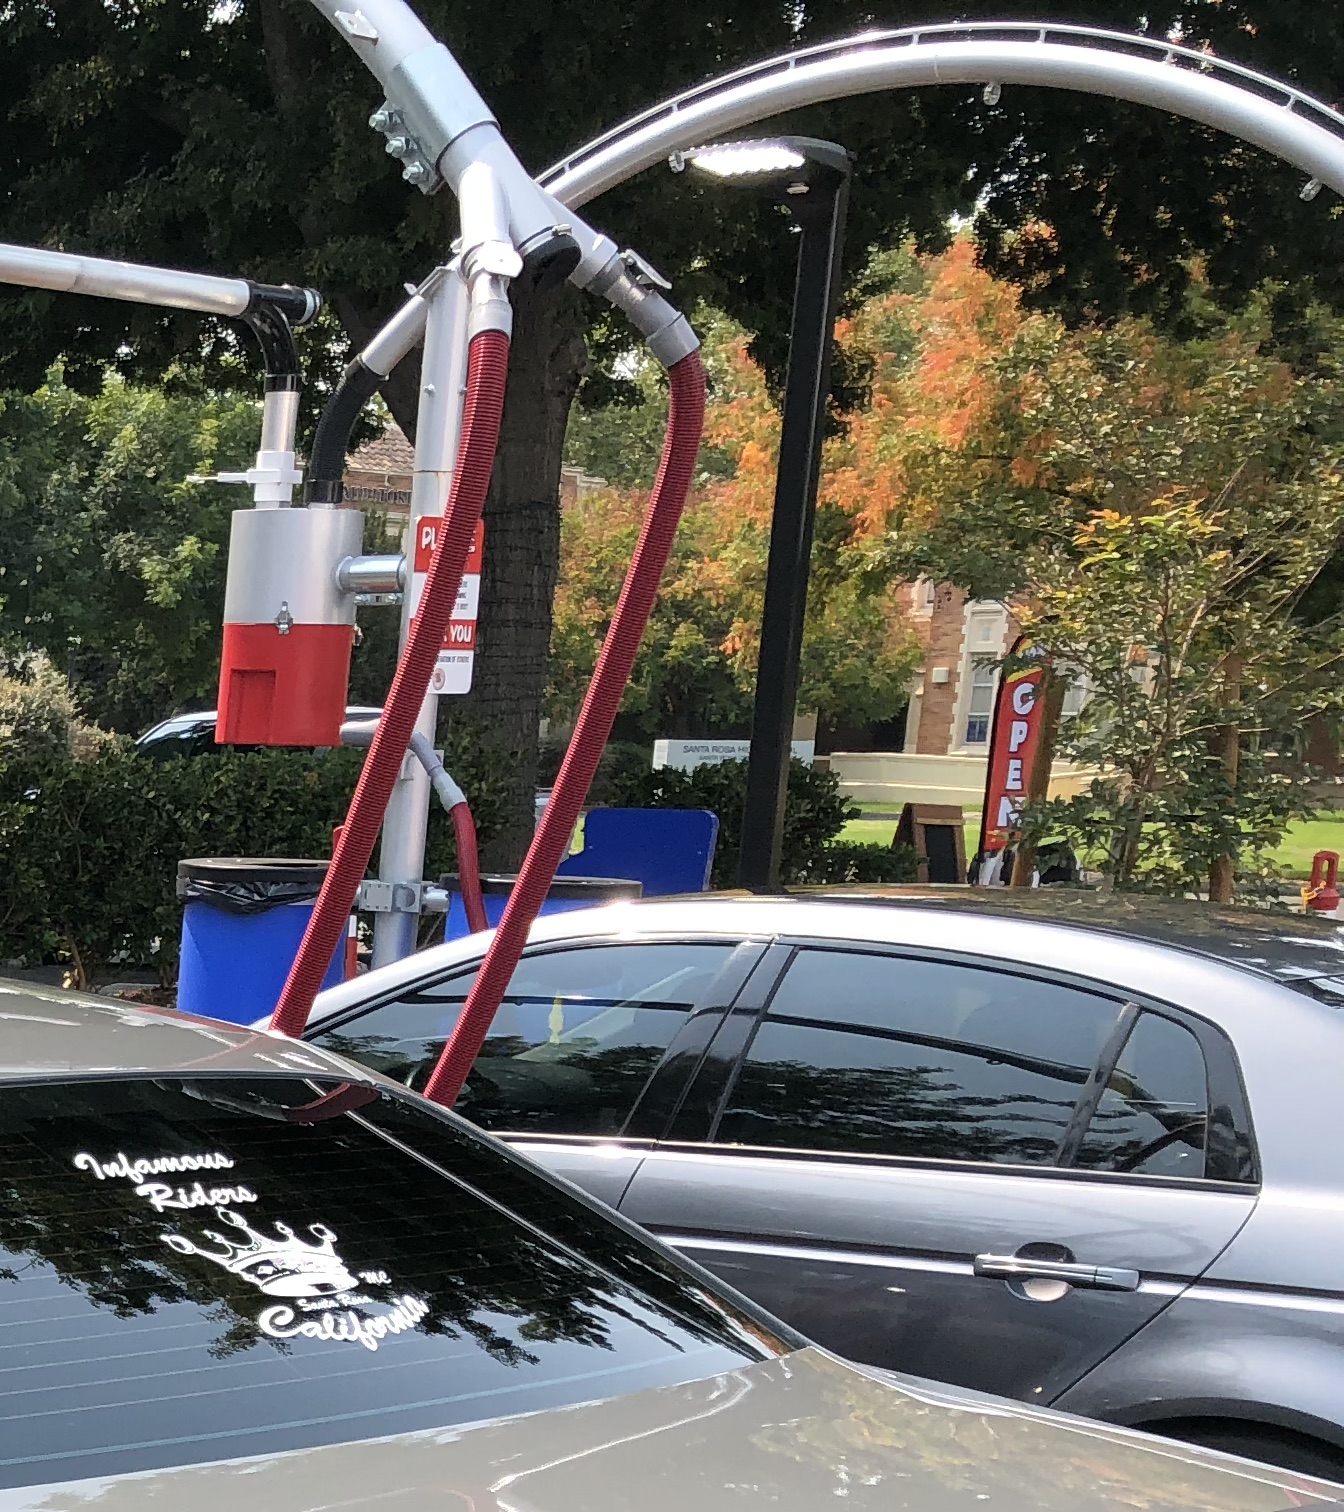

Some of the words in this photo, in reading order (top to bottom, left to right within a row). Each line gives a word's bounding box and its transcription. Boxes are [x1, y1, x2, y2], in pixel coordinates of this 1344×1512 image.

[449, 624, 473, 643] YOU
[683, 745, 710, 753] SANTA
[712, 745, 736, 753] ROSA
[74, 1151, 234, 1184] Infamous
[134, 1182, 258, 1212] Riders
[258, 1294, 430, 1351] California
